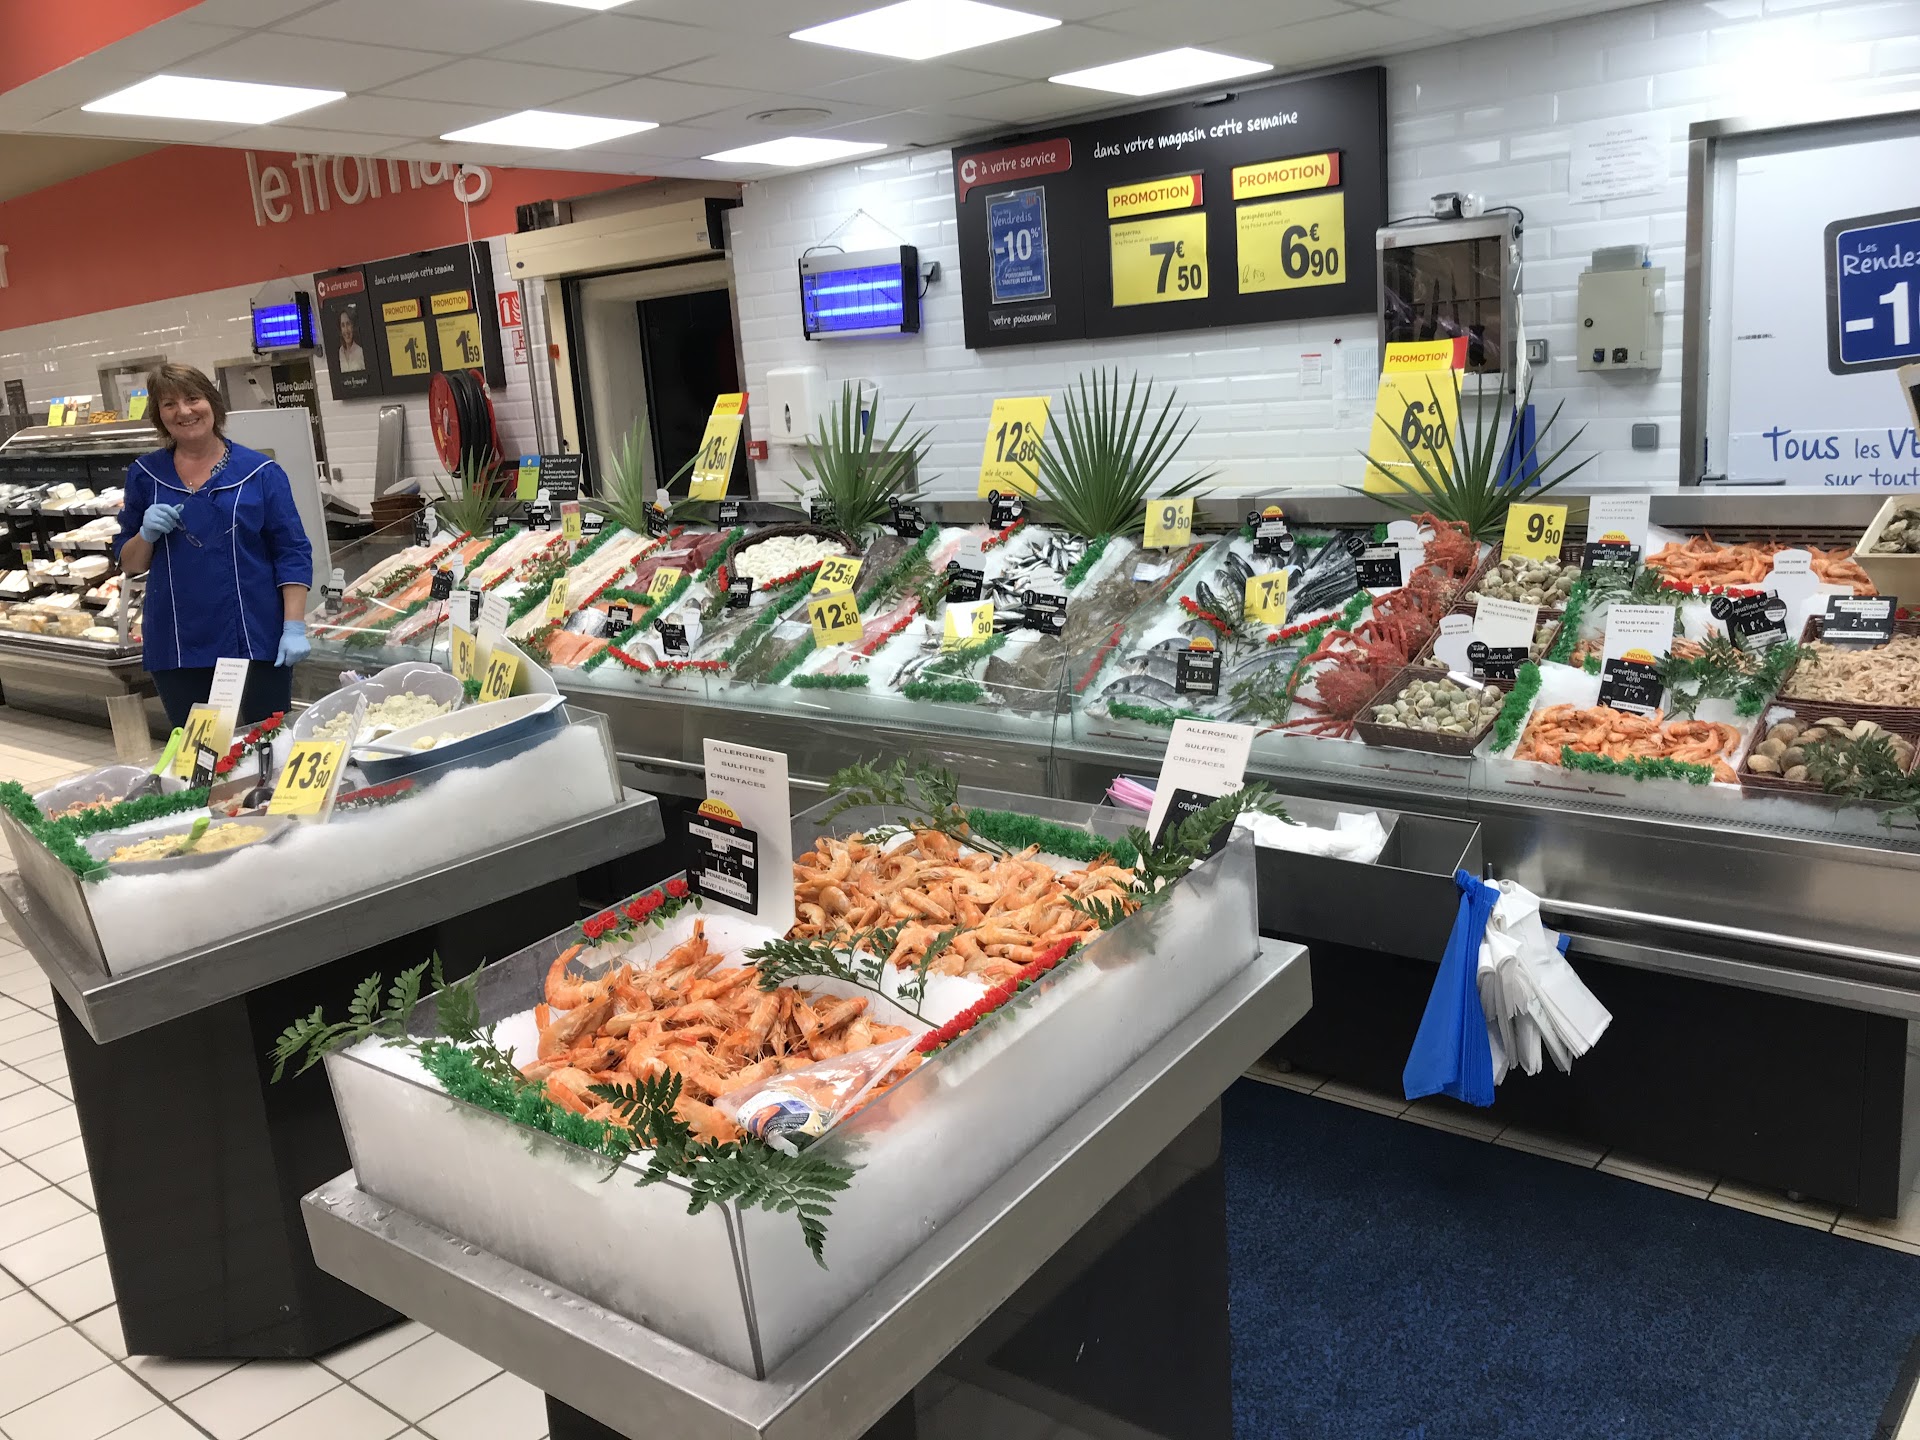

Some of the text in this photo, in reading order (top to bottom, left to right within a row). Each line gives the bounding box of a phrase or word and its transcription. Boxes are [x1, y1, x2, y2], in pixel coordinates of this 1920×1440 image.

[1093, 112, 1298, 159] dans votre magasin cette semaine
[981, 152, 1056, 176] à votre service
[1239, 163, 1325, 188] PROMOTION
[245, 151, 293, 226] le
[1113, 185, 1189, 208] PROMOTION
[992, 211, 1032, 228] Vendredis
[1857, 242, 1878, 253] Les
[433, 295, 467, 308] PROMOTION
[384, 304, 416, 316] PROMOTION
[1845, 281, 1920, 346] -1
[993, 312, 1052, 329] votre poissonnier
[1389, 352, 1448, 363] PROMOTION
[275, 381, 314, 393] Filière Qualité
[278, 394, 306, 404] Carrefour,
[1762, 426, 1840, 462] Tous
[1854, 437, 1881, 459] les
[1824, 473, 1862, 486] sur
[1626, 652, 1652, 660] PROMO
[1612, 668, 1656, 680] crevettes cuites
[1186, 727, 1239, 741] ALLERGENE
[713, 746, 775, 763] ALLERGENES
[1184, 742, 1226, 754] SULFITES
[721, 761, 765, 775] SULFITES
[1173, 756, 1226, 769] CRUSTACES
[710, 772, 766, 789] CRUSTACES
[1222, 781, 1237, 789] 420
[710, 789, 724, 797] 467
[702, 802, 734, 818] PROMO
[695, 827, 719, 840] CREVETTE
[720, 834, 734, 846] CUITE
[706, 870, 728, 883] PENAEUS
[726, 887, 750, 902] EQUATEUR
